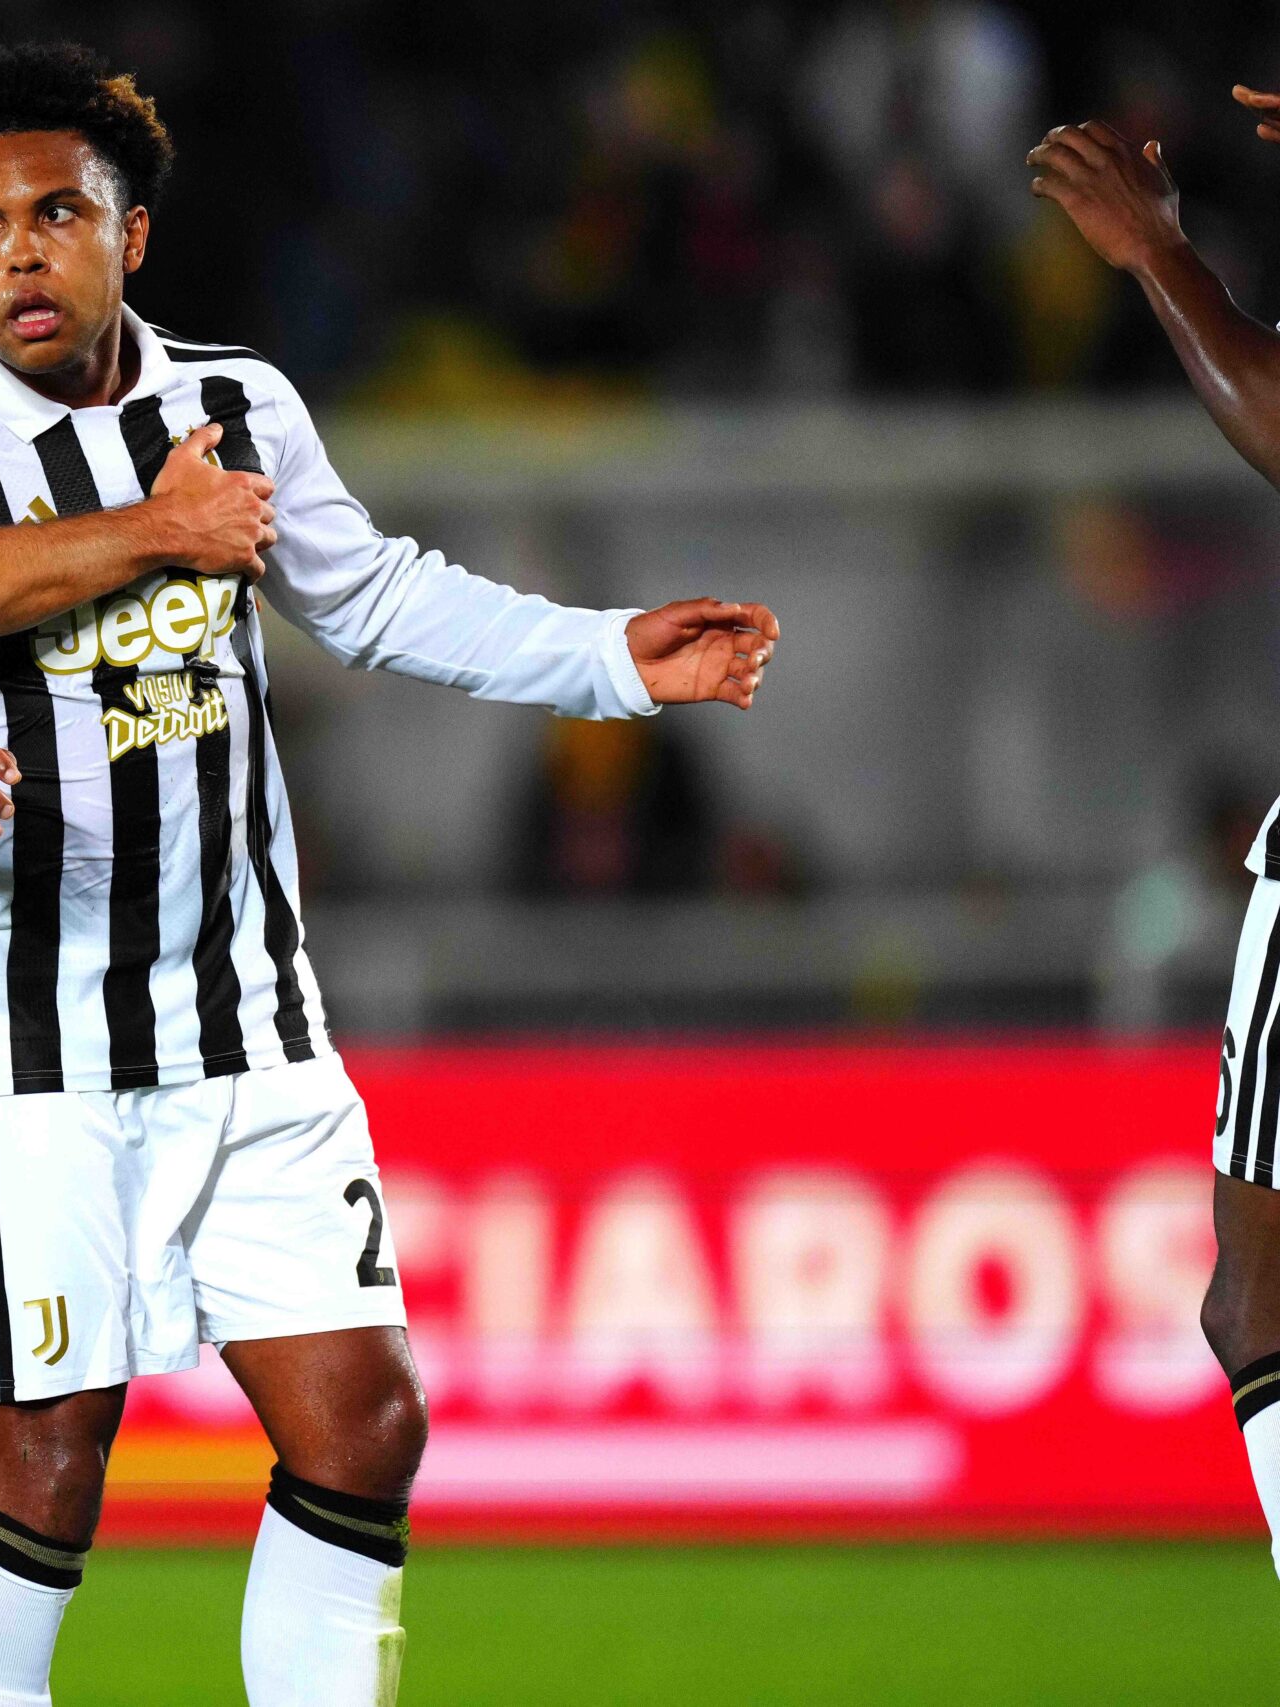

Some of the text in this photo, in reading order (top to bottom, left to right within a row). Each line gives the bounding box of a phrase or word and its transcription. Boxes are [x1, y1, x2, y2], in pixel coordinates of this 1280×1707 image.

[31, 574, 241, 675] Jeep
[100, 687, 228, 762] Detroit
[343, 1178, 396, 1288] 2
